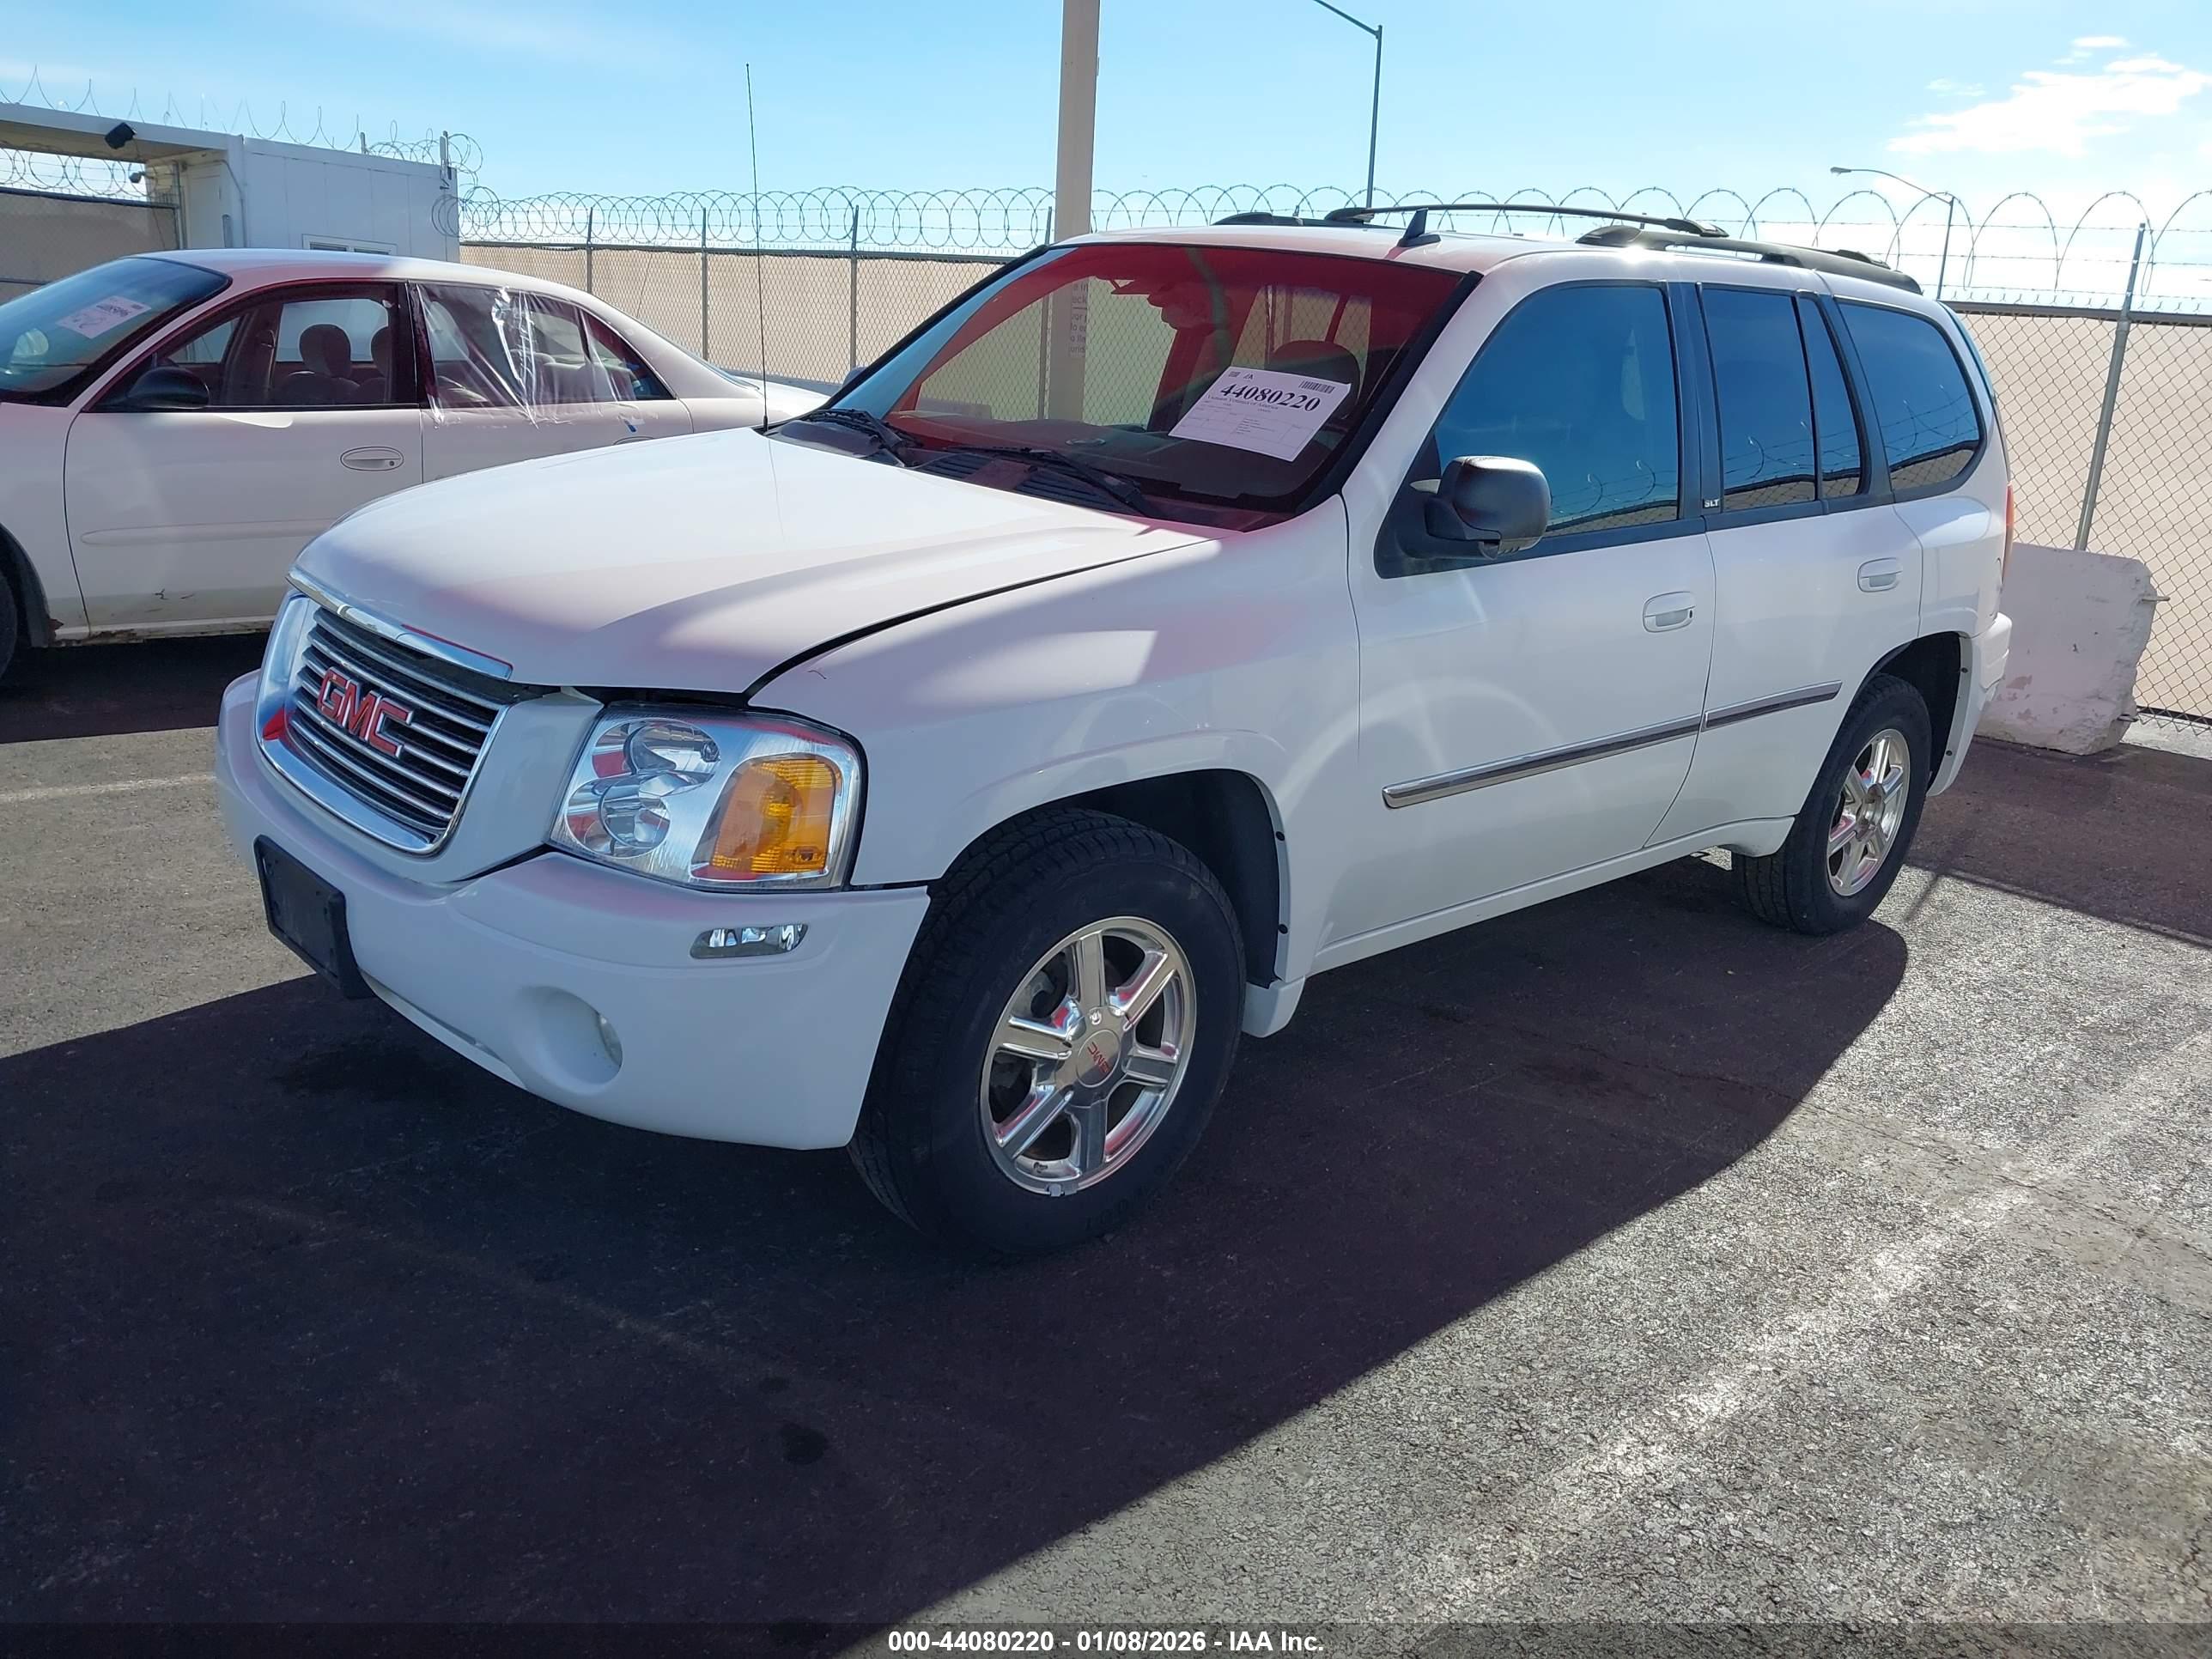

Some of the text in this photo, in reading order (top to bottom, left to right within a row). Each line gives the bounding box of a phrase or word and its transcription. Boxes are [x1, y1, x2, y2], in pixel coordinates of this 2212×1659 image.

[1220, 383, 1321, 411] 44080220
[1705, 499, 1719, 507] SLT
[317, 666, 414, 758] GMC
[1086, 1041, 1111, 1075] GMC
